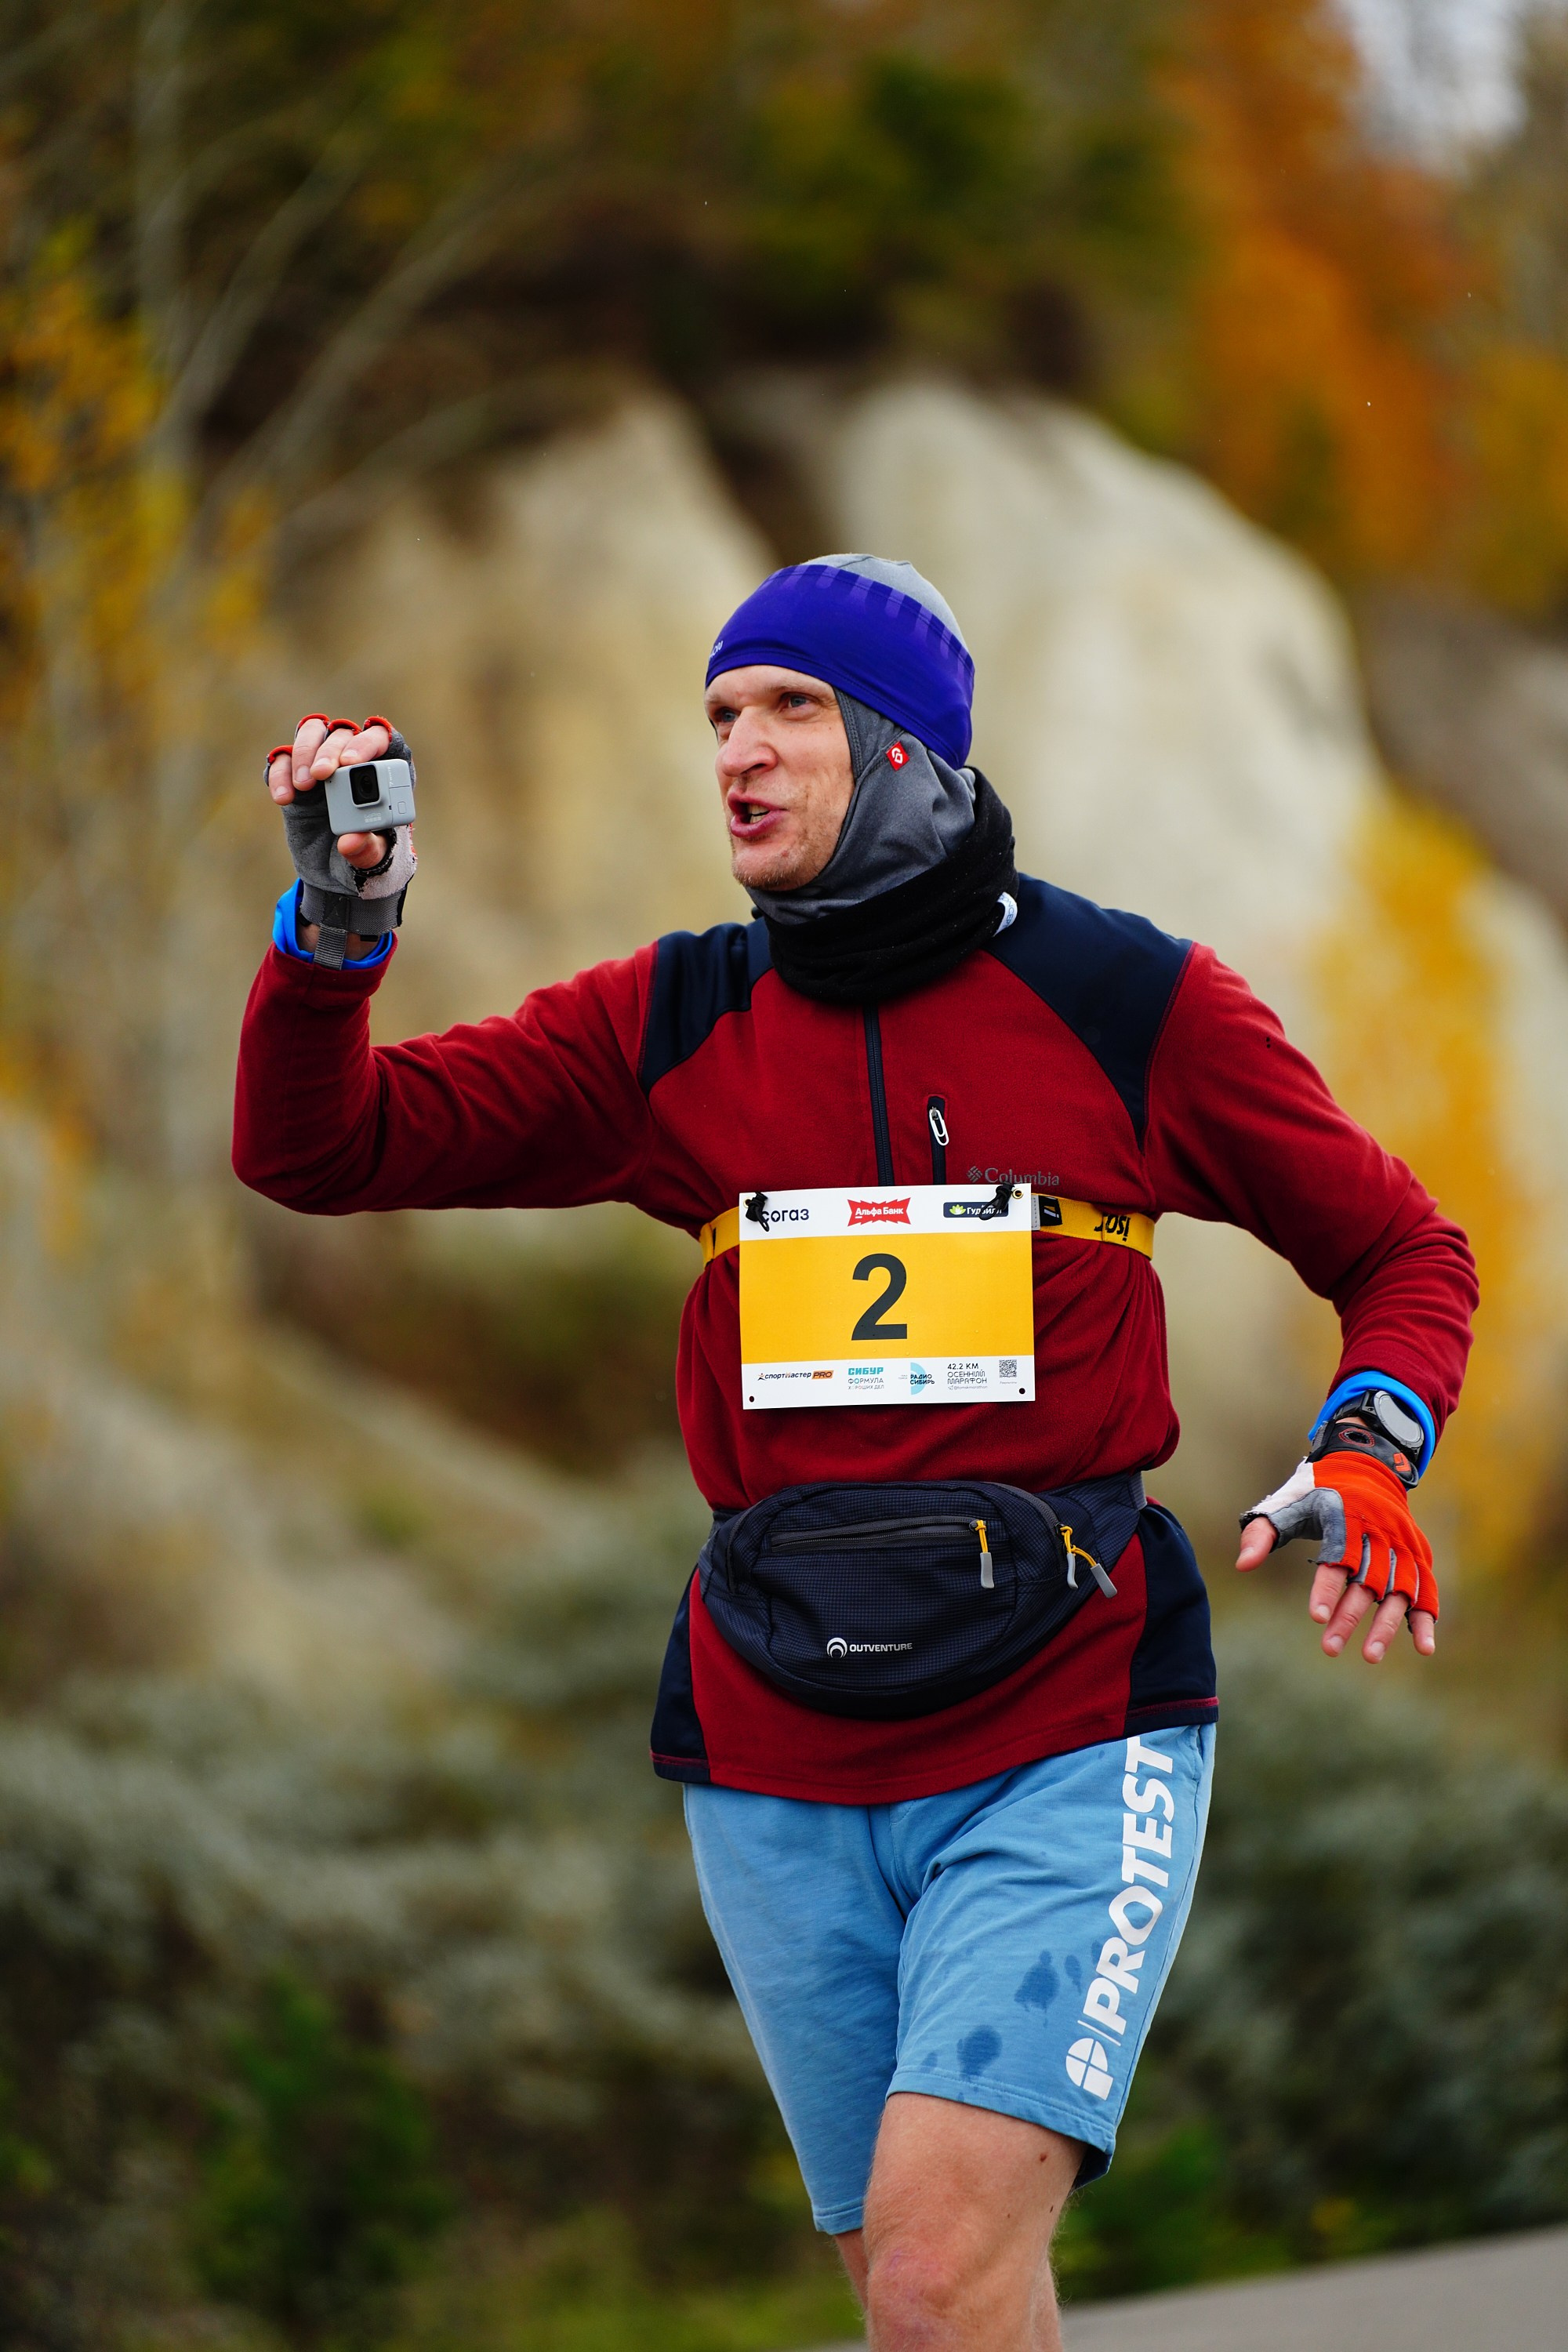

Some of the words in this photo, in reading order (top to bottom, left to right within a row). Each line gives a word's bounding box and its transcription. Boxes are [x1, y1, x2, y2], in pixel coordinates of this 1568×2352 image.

[985, 1167, 1059, 1186] Columbia
[855, 1207, 882, 1219] Альфа
[883, 1206, 904, 1215] Банк
[851, 1253, 908, 1341] 2
[848, 1367, 884, 1375] СИБУР
[849, 1642, 913, 1653] OUTVENTURE
[1082, 1736, 1174, 2036] PROTEST
